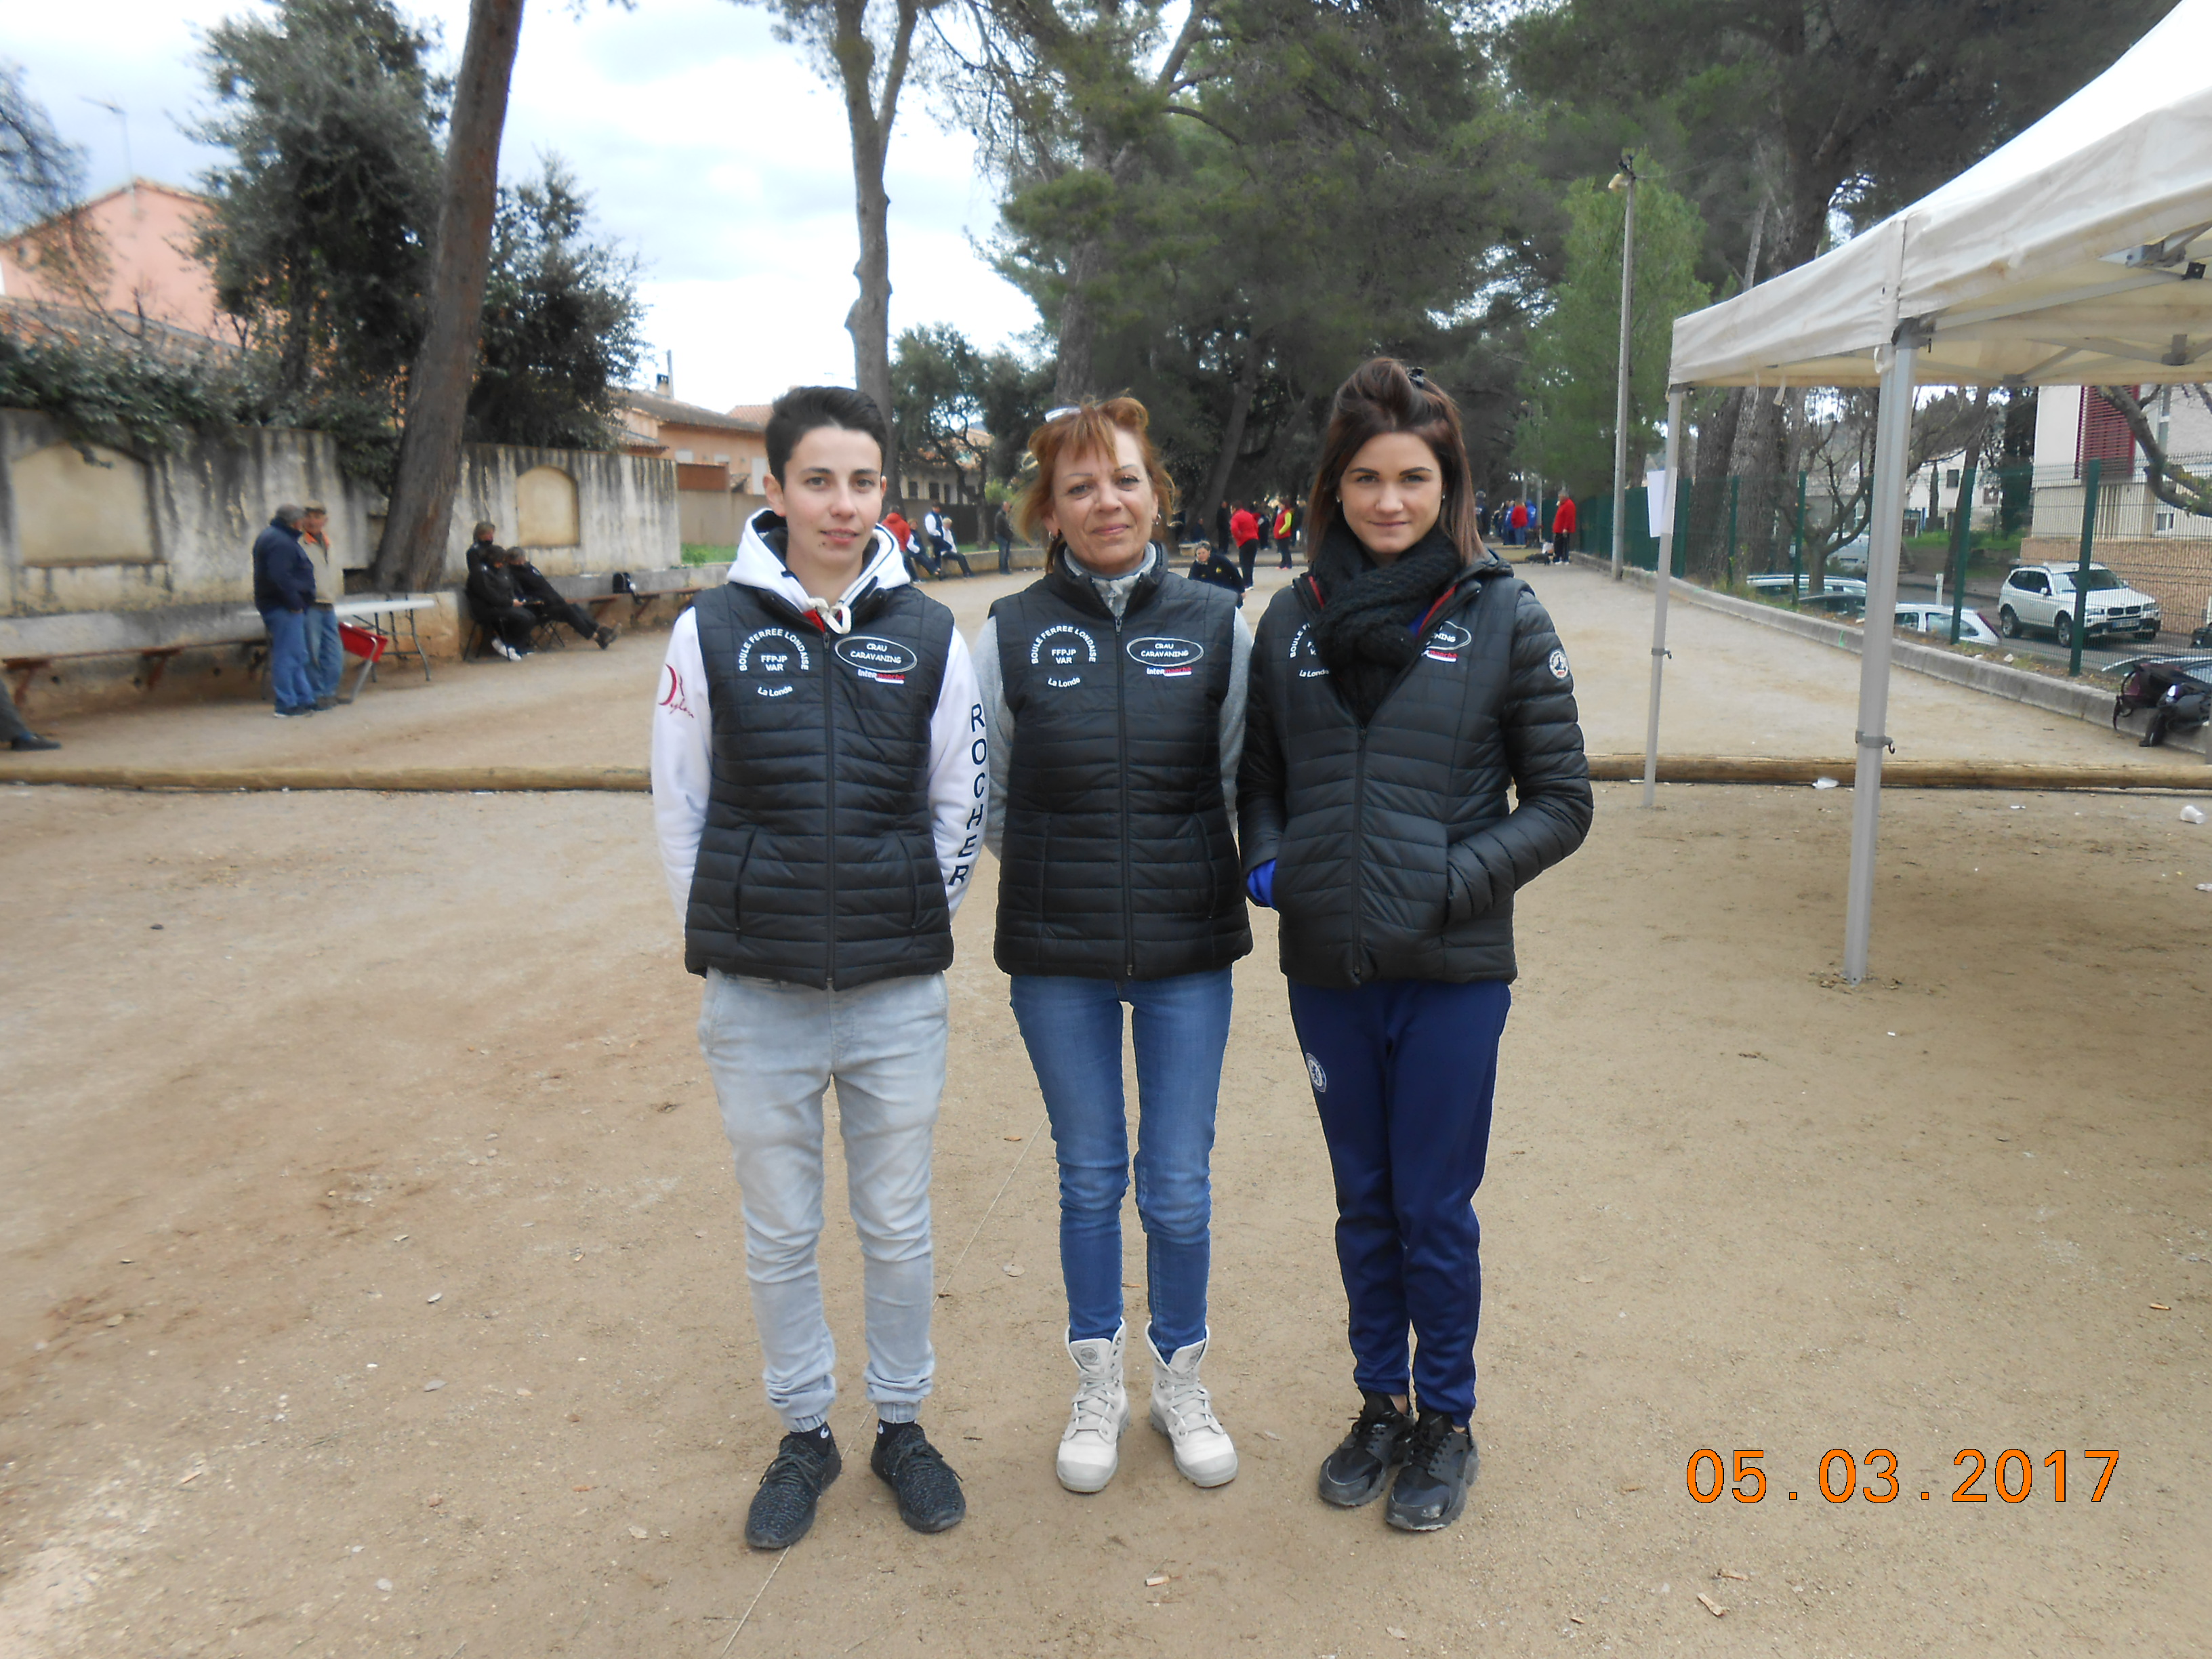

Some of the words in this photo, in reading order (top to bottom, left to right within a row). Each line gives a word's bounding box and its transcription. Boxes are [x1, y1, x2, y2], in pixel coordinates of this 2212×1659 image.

[866, 643, 888, 652] CRAU
[1031, 637, 1043, 664] BOULE
[1040, 626, 1074, 639] FERREE
[1074, 628, 1097, 663] LONDAISE
[1290, 630, 1303, 658] BOULE
[739, 642, 752, 672] BOULE
[748, 628, 784, 644] FERREE
[784, 631, 809, 670] LONDAISE
[1051, 648, 1077, 657] FFPJP
[760, 655, 787, 663] FFPJP
[850, 651, 902, 664] CARAVANING
[765, 663, 784, 672] VAR
[1298, 669, 1307, 677] La
[1047, 677, 1057, 687] La
[757, 686, 768, 696] La
[949, 703, 987, 886] ROCHER
